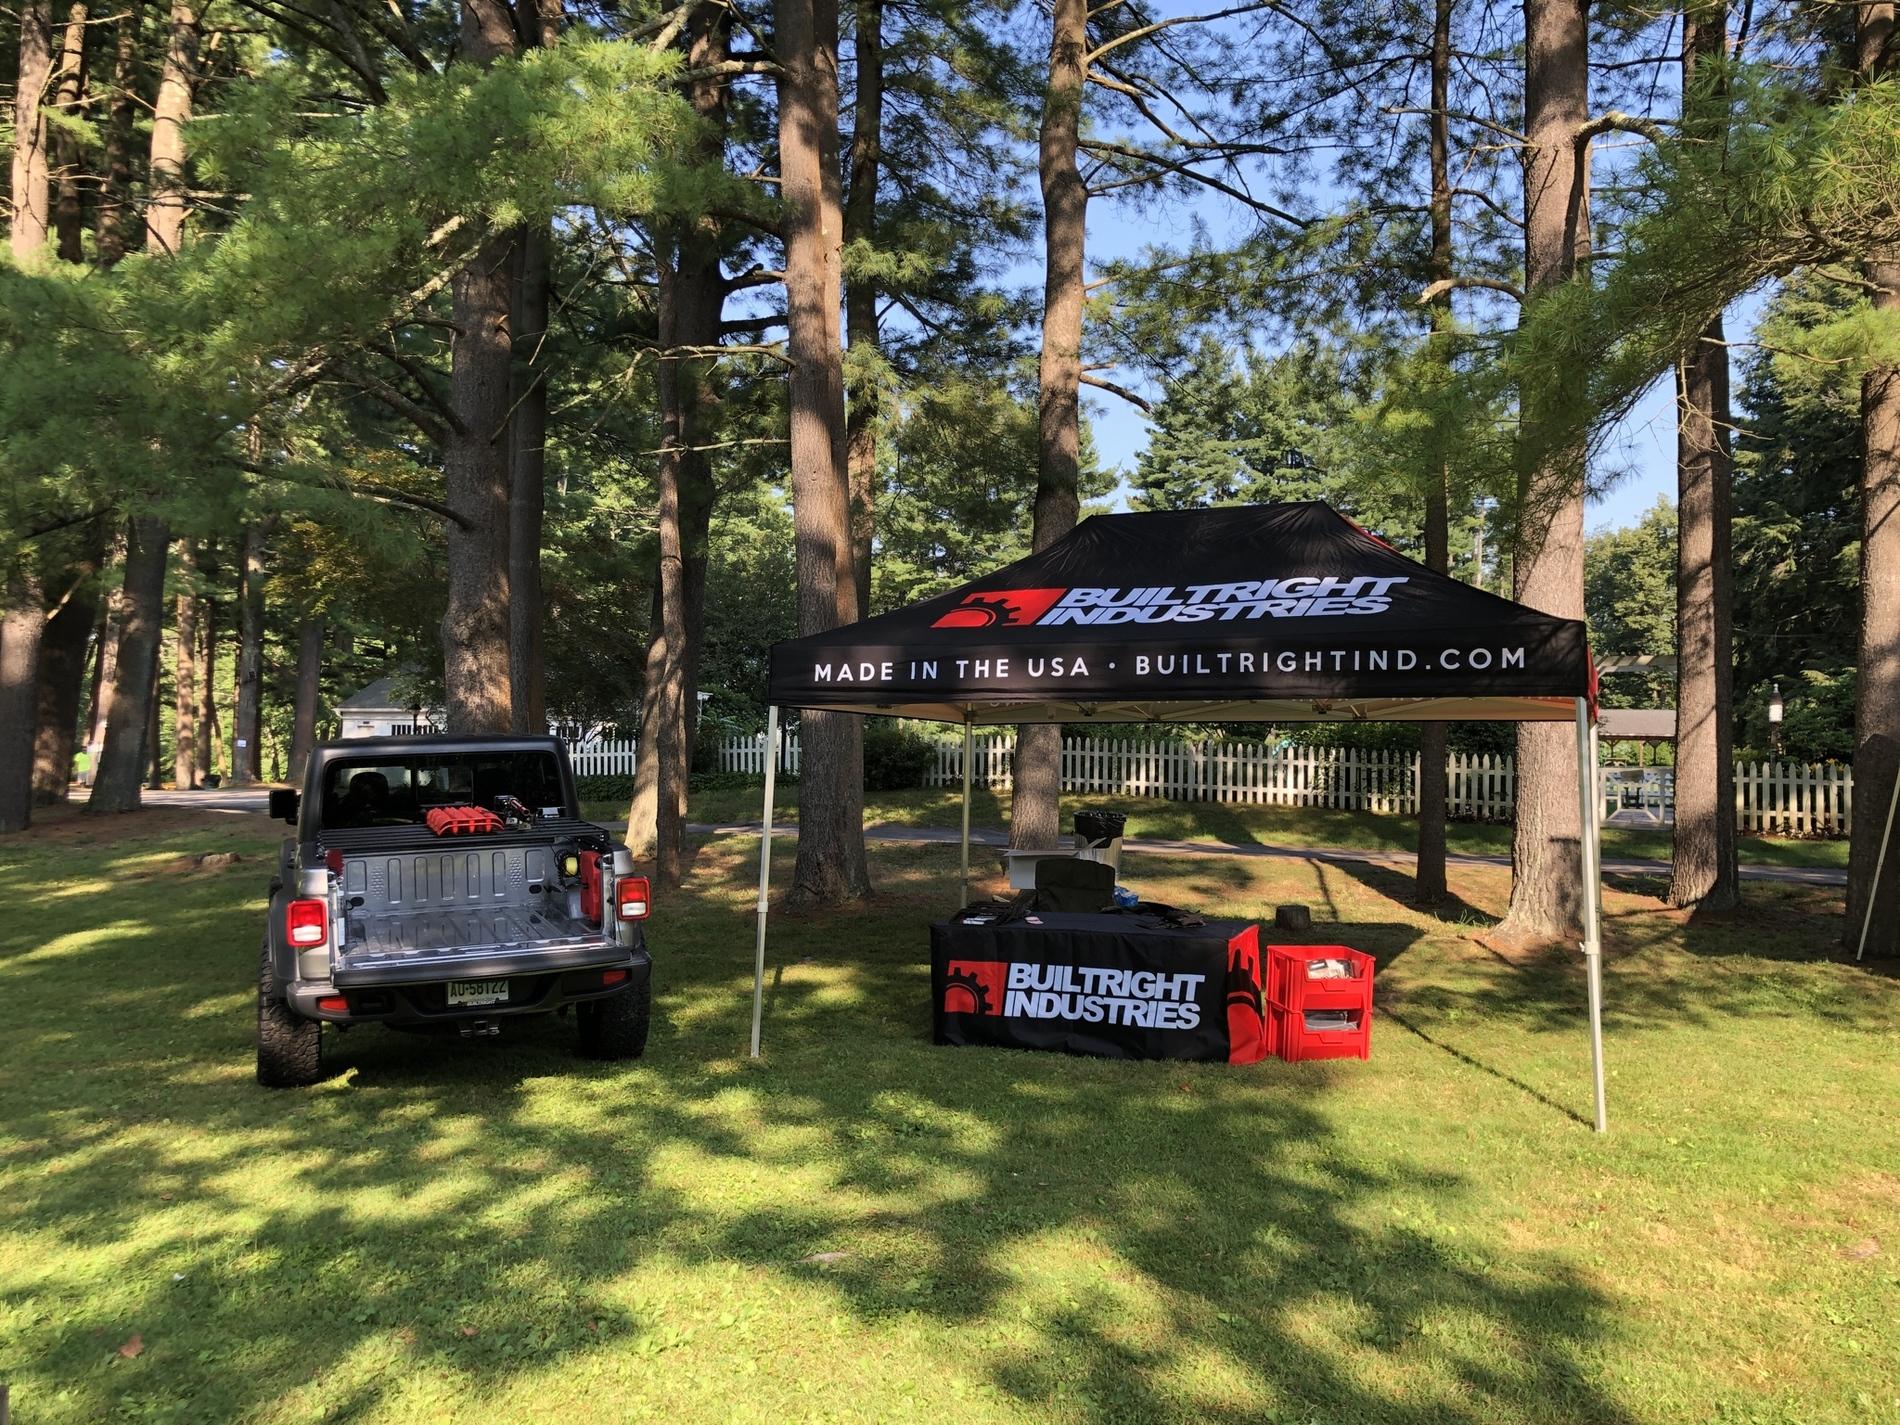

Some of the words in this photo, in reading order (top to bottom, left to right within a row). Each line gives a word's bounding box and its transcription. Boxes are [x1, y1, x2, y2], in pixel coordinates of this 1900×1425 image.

[1058, 576, 1410, 608] BUILTRIGHT
[1035, 596, 1393, 626] INDUSTRIES
[814, 662, 893, 682] MADE
[910, 661, 937, 680] IN
[956, 658, 1009, 679] THE
[1028, 656, 1089, 678] USA
[1136, 647, 1525, 675] BUILTRIGHTIND.COM
[1007, 962, 1205, 1001] BUILTRIGHT
[1004, 990, 1201, 1030] INDUSTRIES
